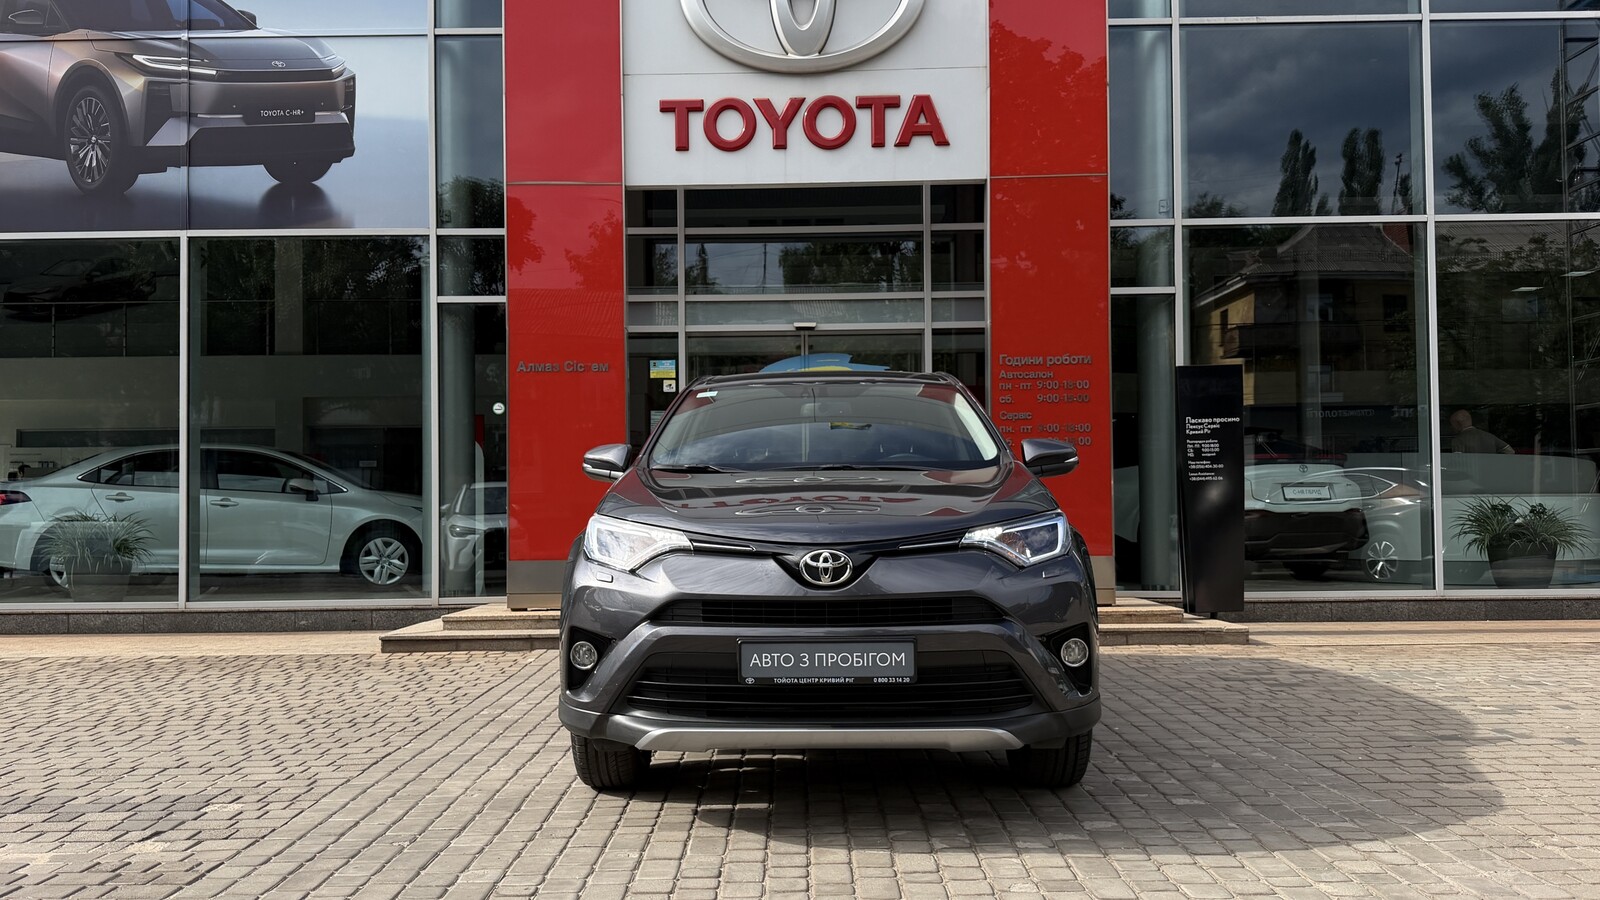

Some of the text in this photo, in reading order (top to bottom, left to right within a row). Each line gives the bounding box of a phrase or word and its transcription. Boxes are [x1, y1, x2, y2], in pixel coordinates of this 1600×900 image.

[260, 109, 284, 117] TOYOTA
[659, 95, 950, 152] TOYOTA
[999, 353, 1092, 367] Години роботи
[516, 360, 560, 372] Алмаз
[999, 370, 1053, 379] Автосалон
[999, 395, 1014, 403] сб.
[999, 411, 1032, 421] Сервіс
[749, 652, 905, 667] АВТО З ПРОБІГОМ
[820, 676, 844, 684] КРИВИЙ
